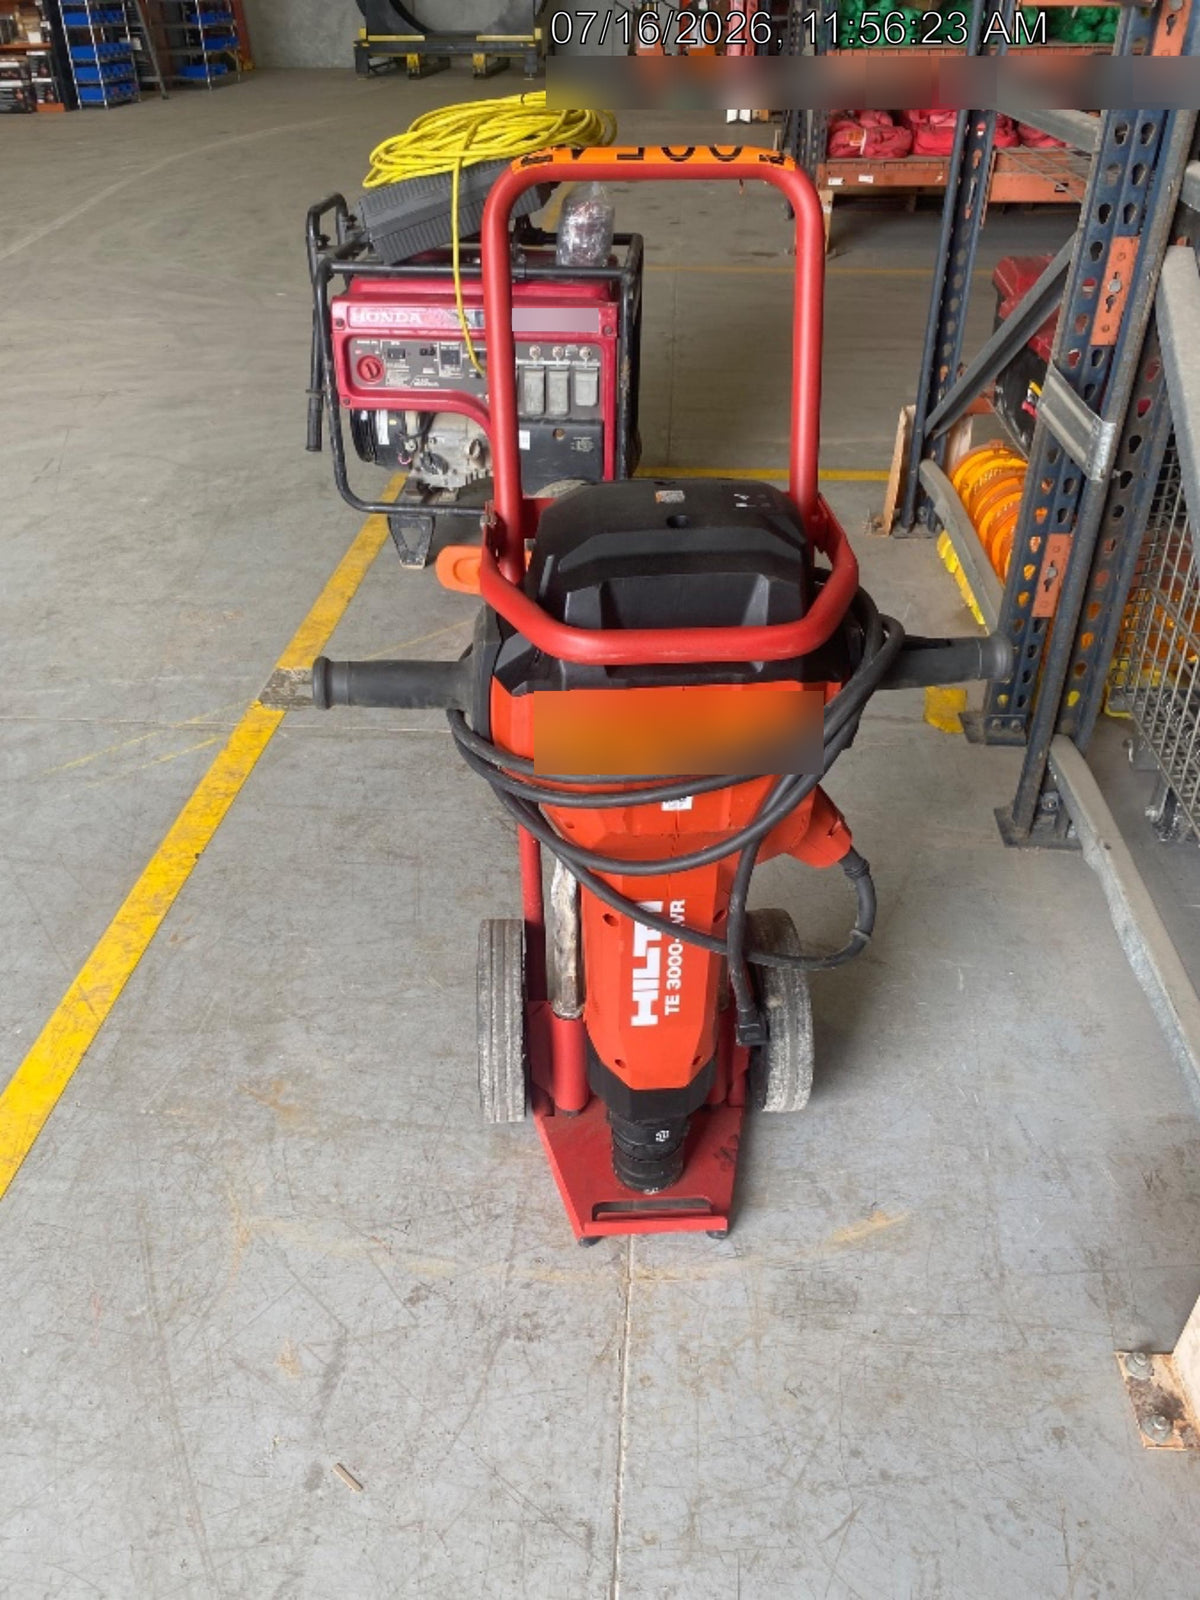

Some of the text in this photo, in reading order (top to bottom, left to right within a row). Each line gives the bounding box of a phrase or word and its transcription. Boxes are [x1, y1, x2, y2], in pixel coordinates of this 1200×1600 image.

[350, 311, 422, 324] HONDA
[665, 900, 686, 1015] TE 3000-VR
